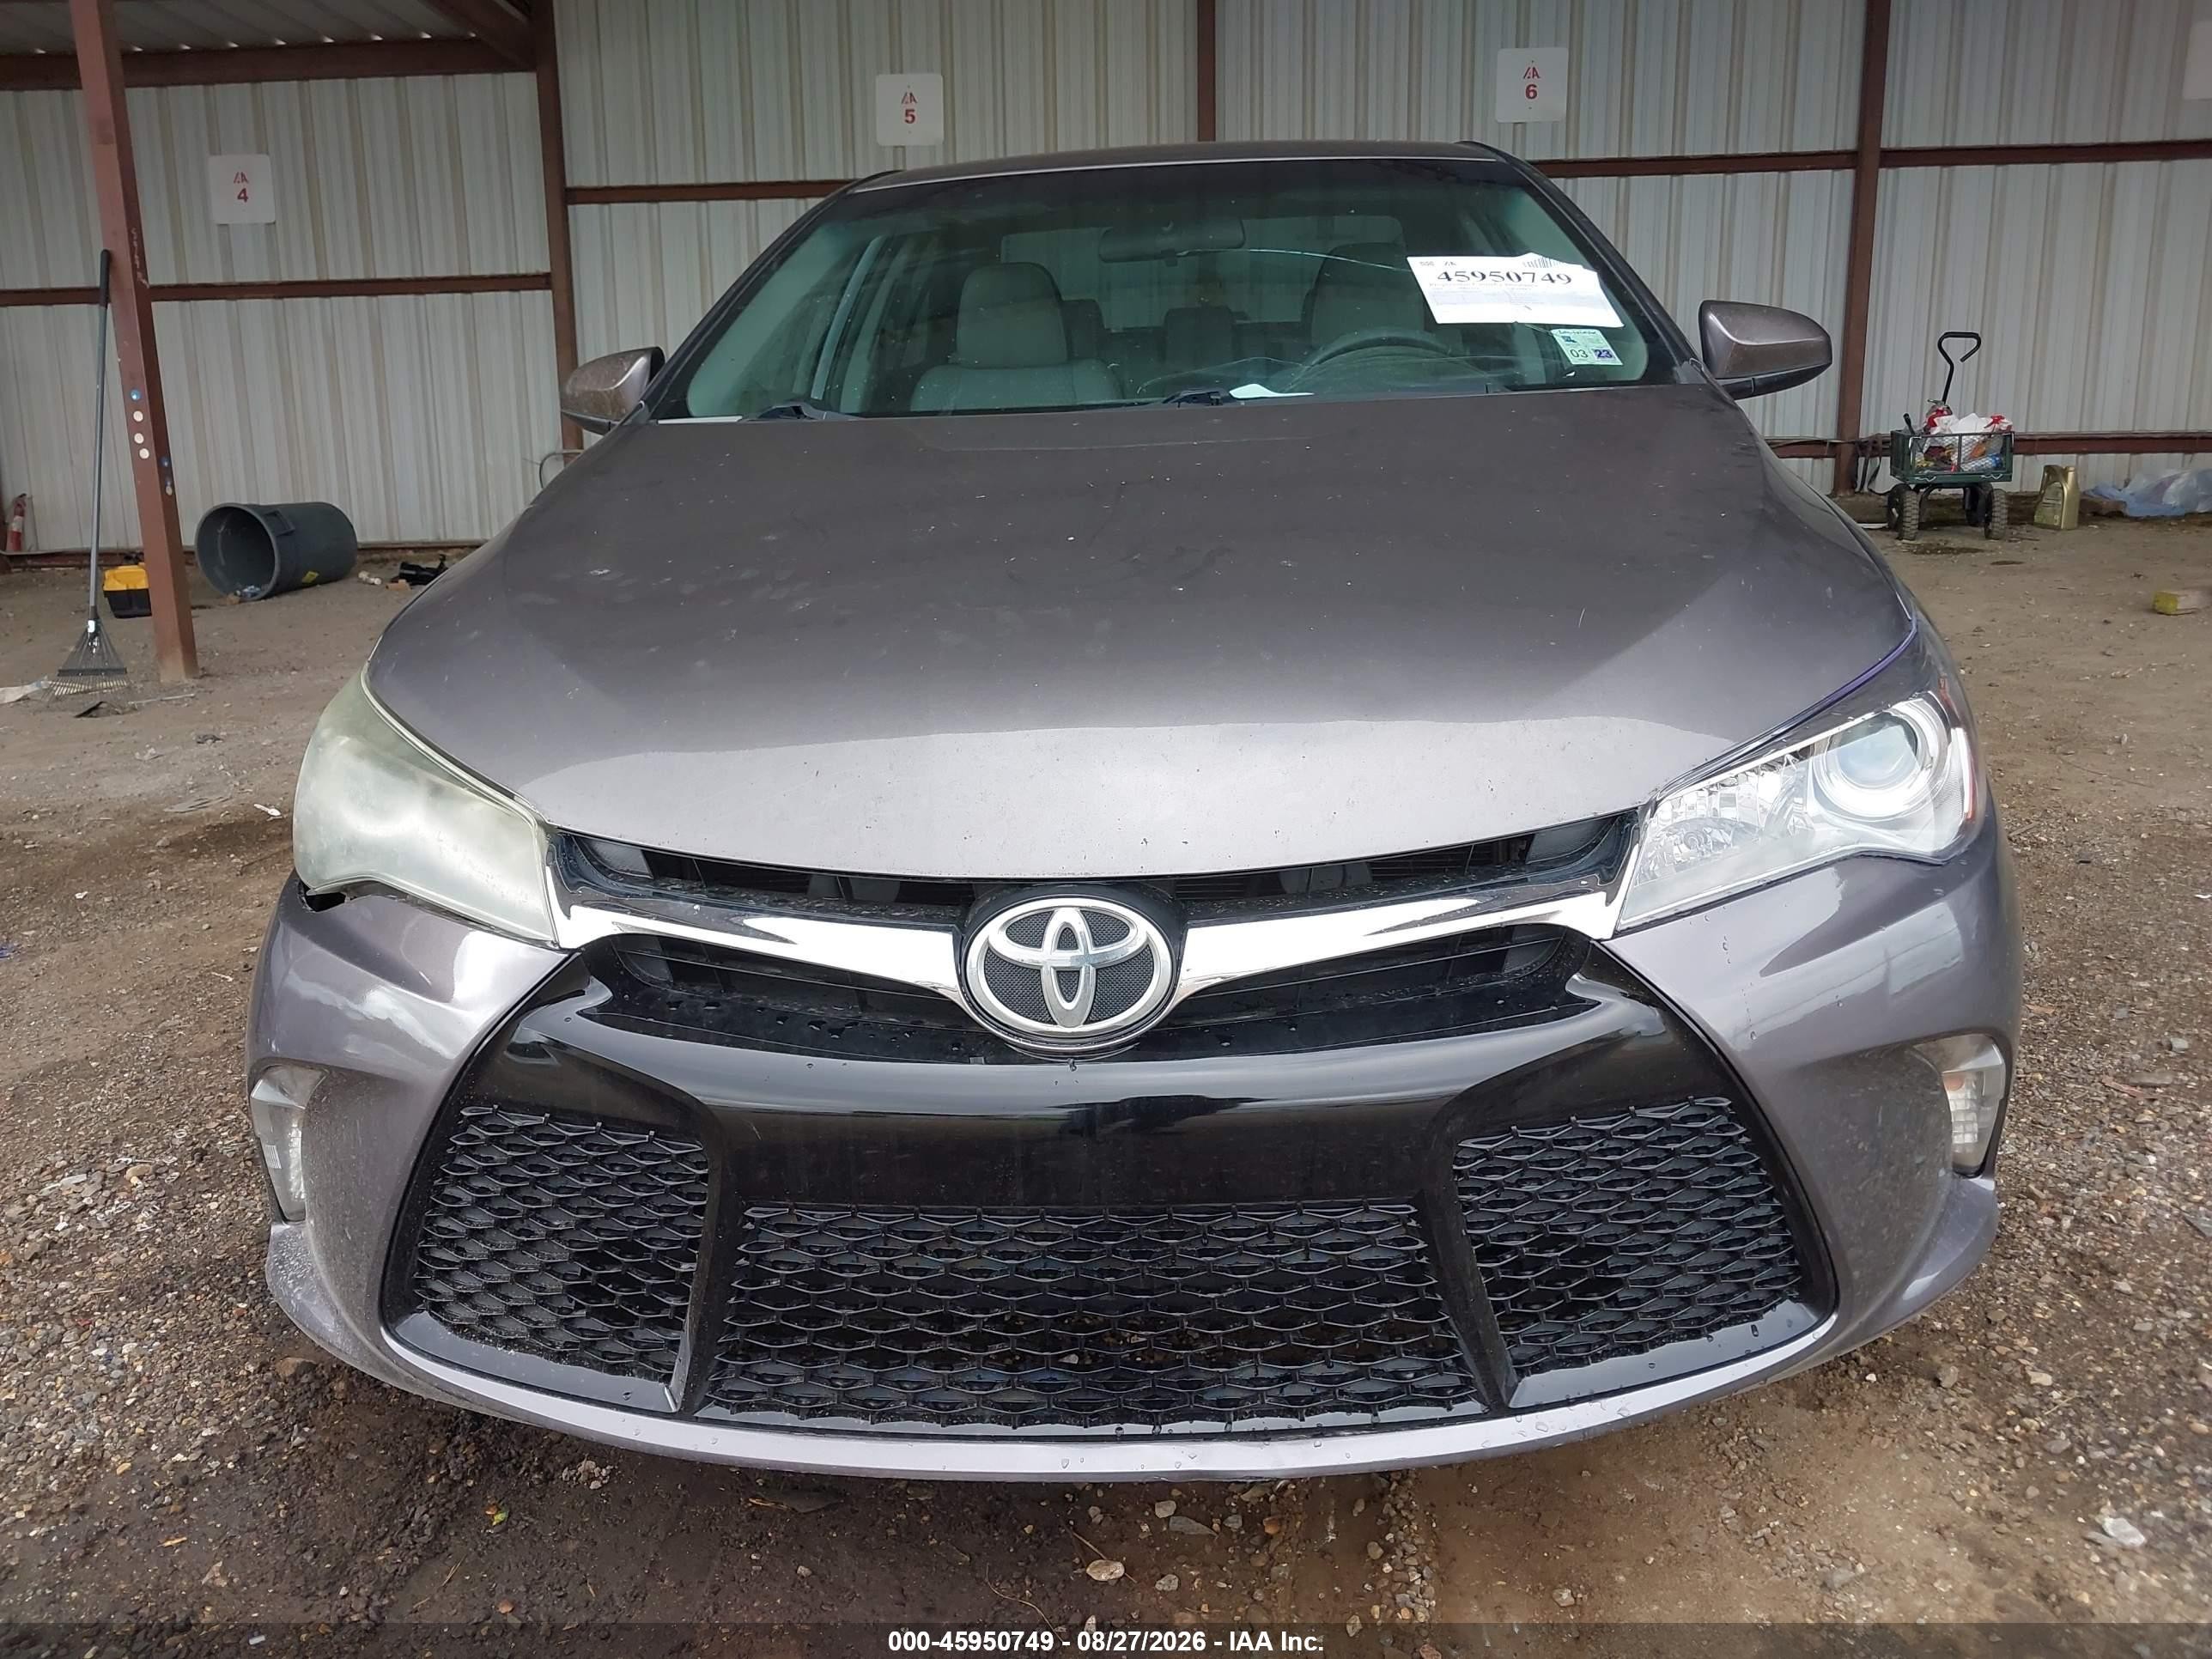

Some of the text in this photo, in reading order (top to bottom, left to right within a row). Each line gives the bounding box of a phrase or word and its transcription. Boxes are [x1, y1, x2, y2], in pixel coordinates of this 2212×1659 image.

[1525, 83, 1538, 100] 6
[904, 108, 915, 125] 5
[237, 187, 249, 203] 4
[1437, 270, 1572, 285] 45950749
[1570, 349, 1613, 359] 03 23
